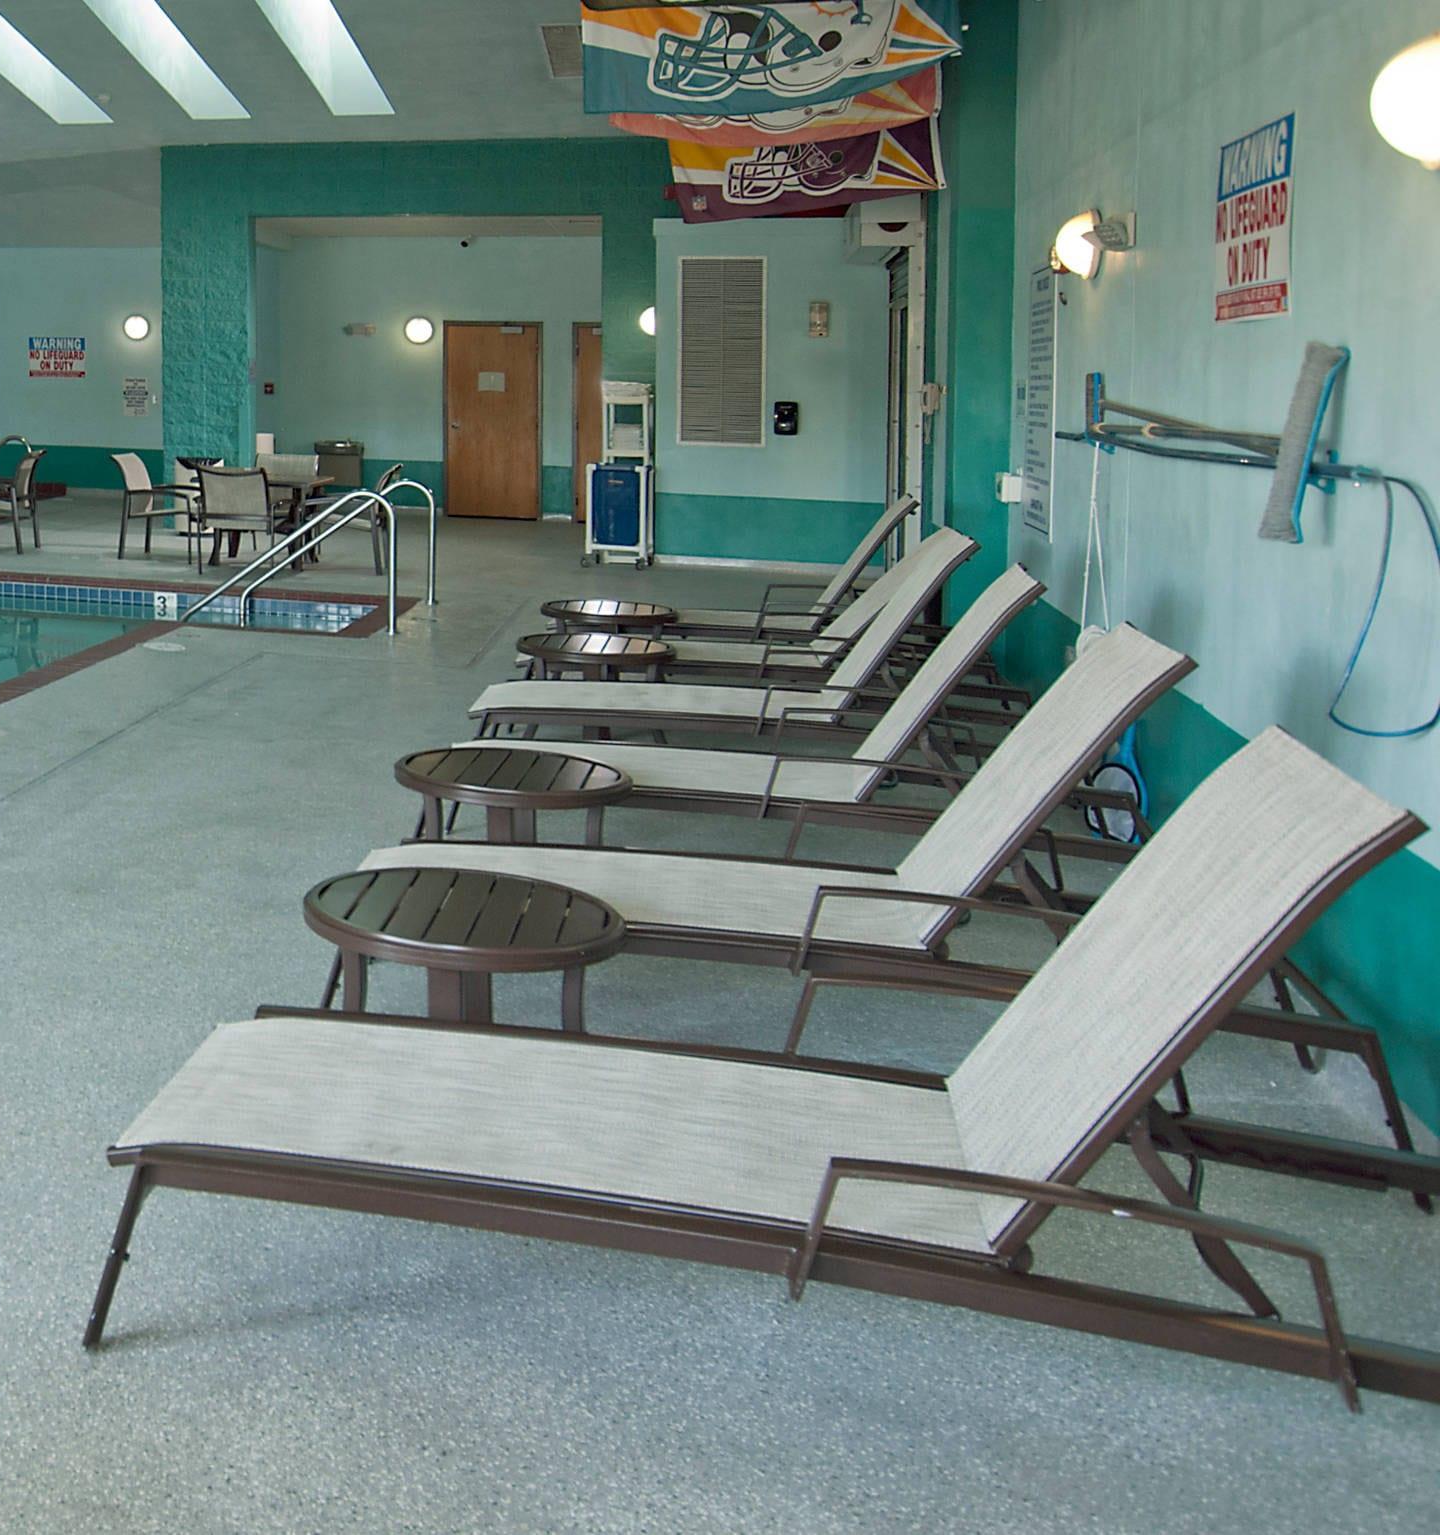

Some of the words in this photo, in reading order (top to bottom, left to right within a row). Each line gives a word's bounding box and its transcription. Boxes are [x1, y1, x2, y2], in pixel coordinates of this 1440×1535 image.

[1221, 119, 1289, 197] WARNING
[1216, 201, 1227, 244] NO
[1229, 181, 1288, 240] LIFEGUARD
[1227, 247, 1239, 287] ON
[1241, 236, 1270, 283] DUTY
[32, 337, 81, 350] WARNING
[29, 350, 40, 360] NO
[43, 351, 84, 361] LIFEGUARD
[40, 361, 50, 370] ON
[53, 361, 74, 370] DUTY
[157, 595, 167, 608] 3
